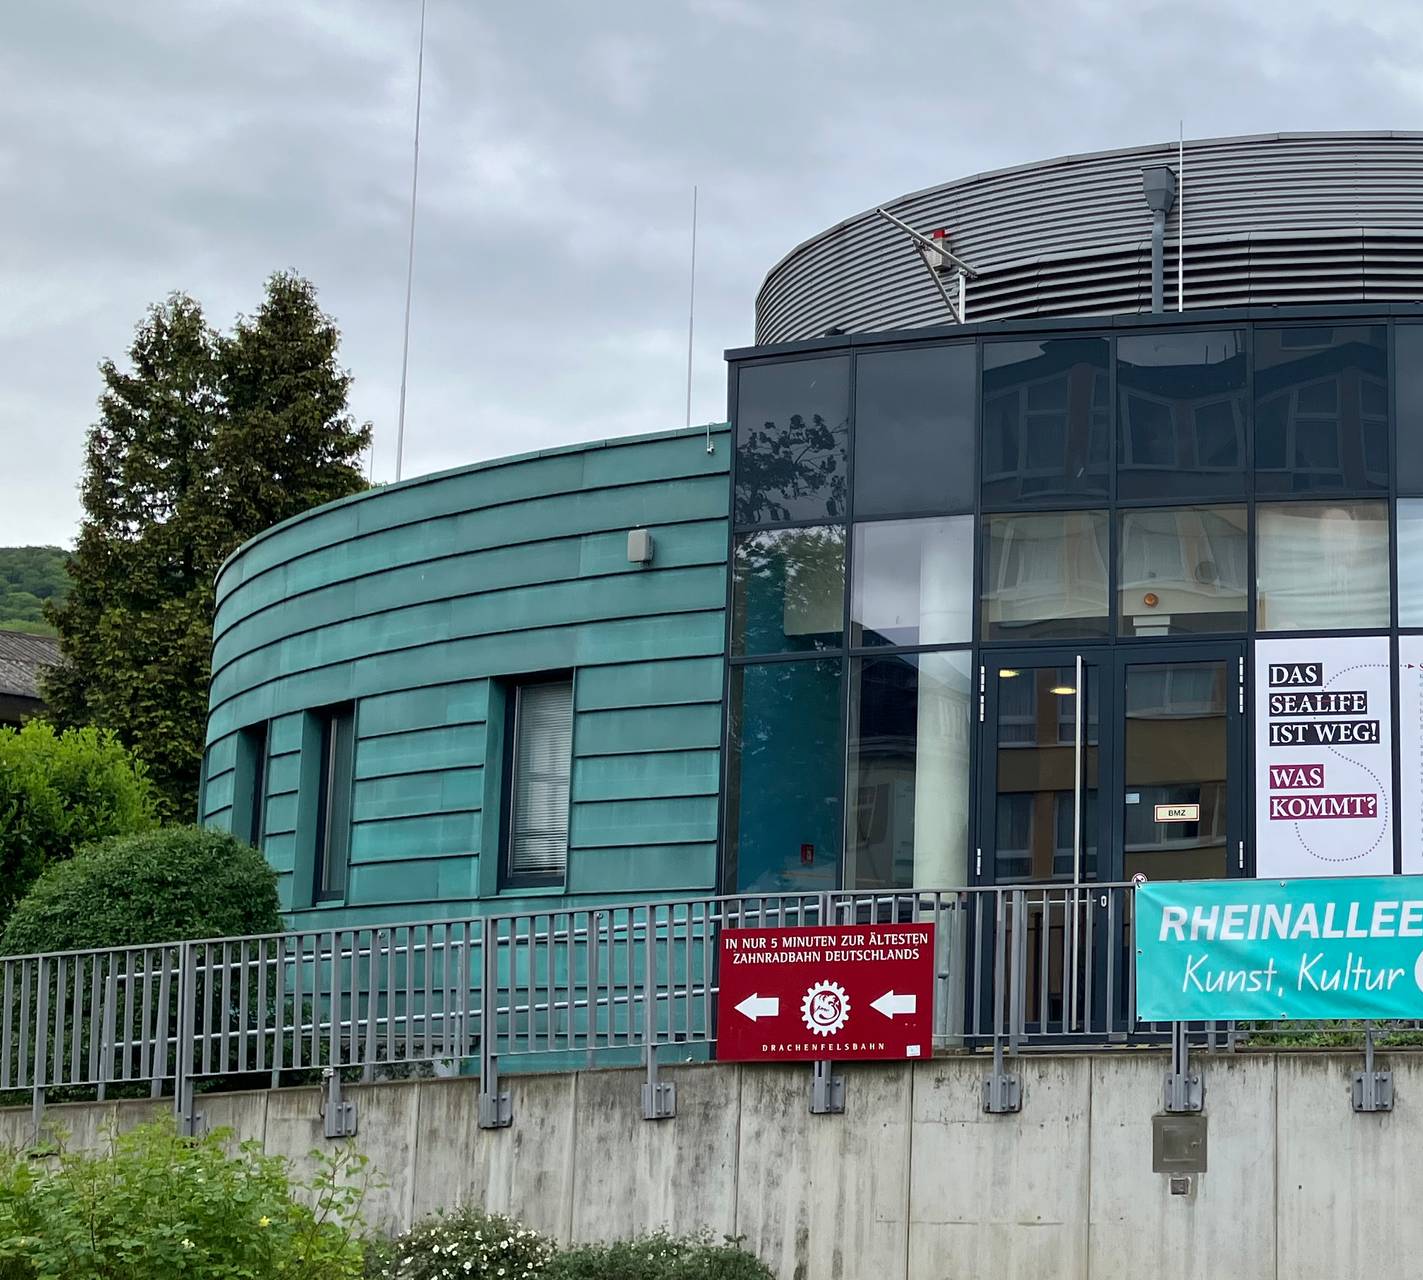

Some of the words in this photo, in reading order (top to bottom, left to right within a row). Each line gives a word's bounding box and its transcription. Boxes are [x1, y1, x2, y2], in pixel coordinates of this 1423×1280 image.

[1271, 665, 1317, 684] DAS
[1271, 694, 1366, 713] SEALIFE
[1271, 724, 1308, 743] IST
[1313, 722, 1377, 742] WEG!
[1271, 768, 1322, 787] WAS
[1168, 809, 1186, 817] BMZ
[1271, 797, 1377, 817] KOMMT?
[725, 938, 738, 950] IN
[742, 937, 767, 949] NUR
[770, 937, 778, 949] 5
[782, 935, 836, 948] MINUTEN
[841, 934, 865, 946] ZUR
[869, 932, 928, 946] ÄLTESTEN
[733, 951, 821, 964] ZAHNRADBAHN
[825, 948, 920, 962] DEUTSCHLANDS
[1181, 954, 1284, 997] Kunst,
[1297, 952, 1405, 992] Kultur
[762, 1042, 885, 1052] DRACHENFELSBAHN
